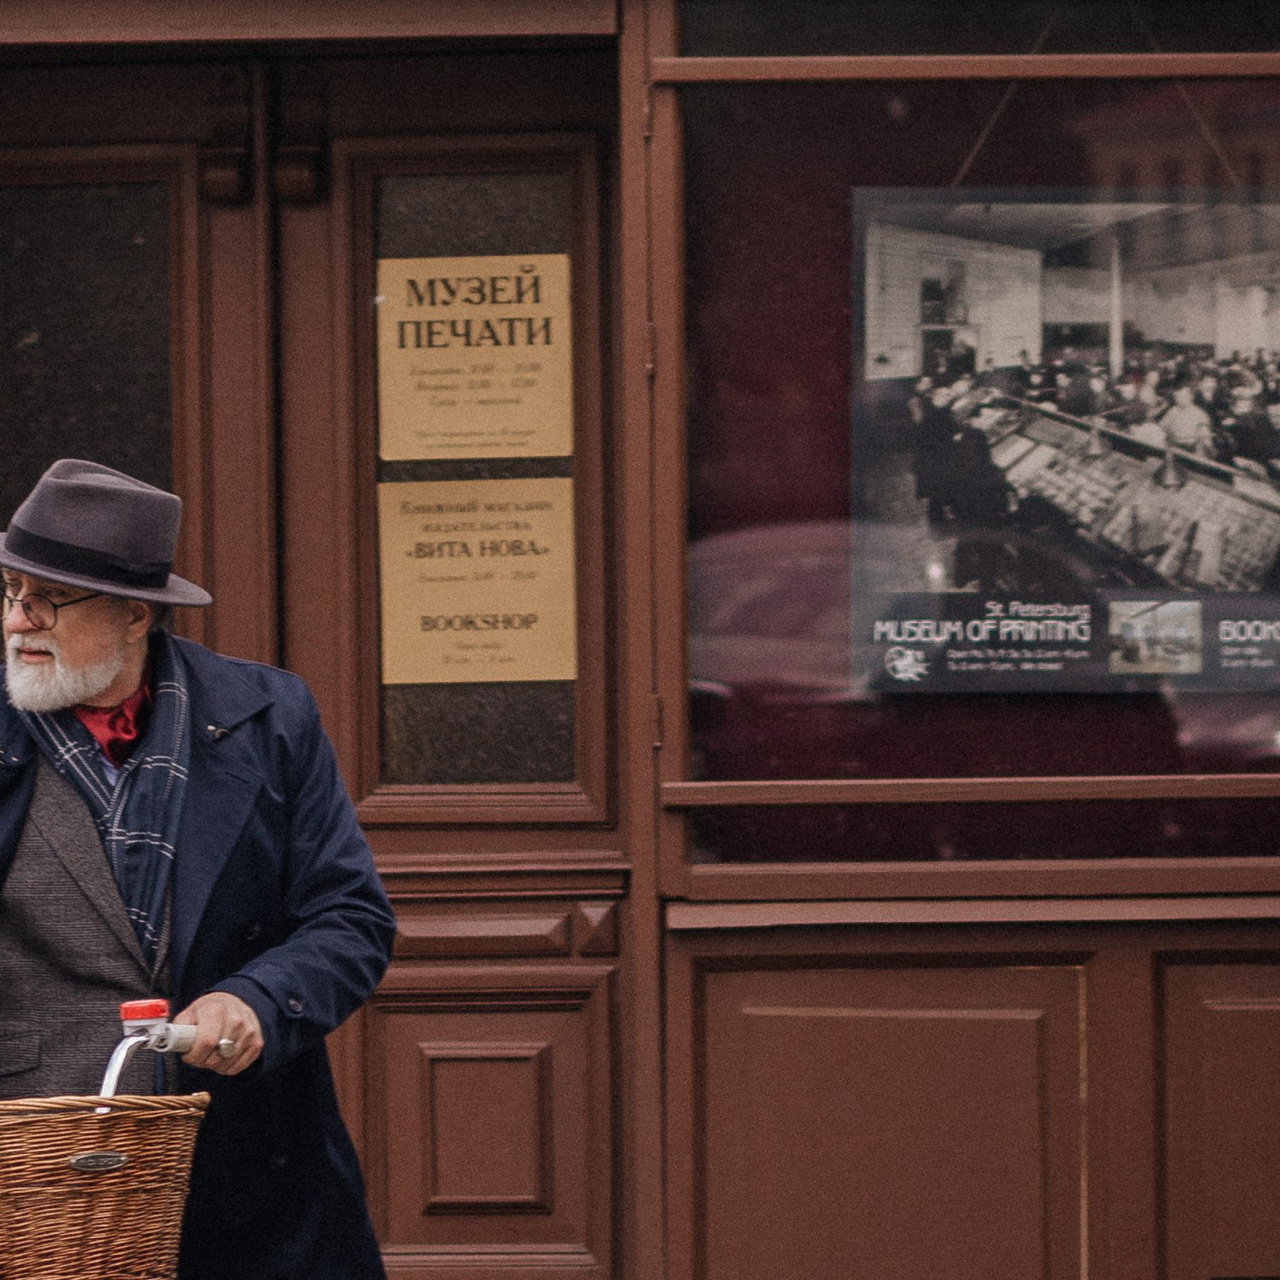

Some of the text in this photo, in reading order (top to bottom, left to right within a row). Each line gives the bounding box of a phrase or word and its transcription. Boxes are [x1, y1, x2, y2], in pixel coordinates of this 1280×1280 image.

[406, 264, 541, 307] МУЗЕЙ
[397, 317, 553, 349] ПЕЧАТИ
[420, 613, 539, 632] BOOKSHOP
[873, 620, 1091, 641] MUSEUM OF PRINTING
